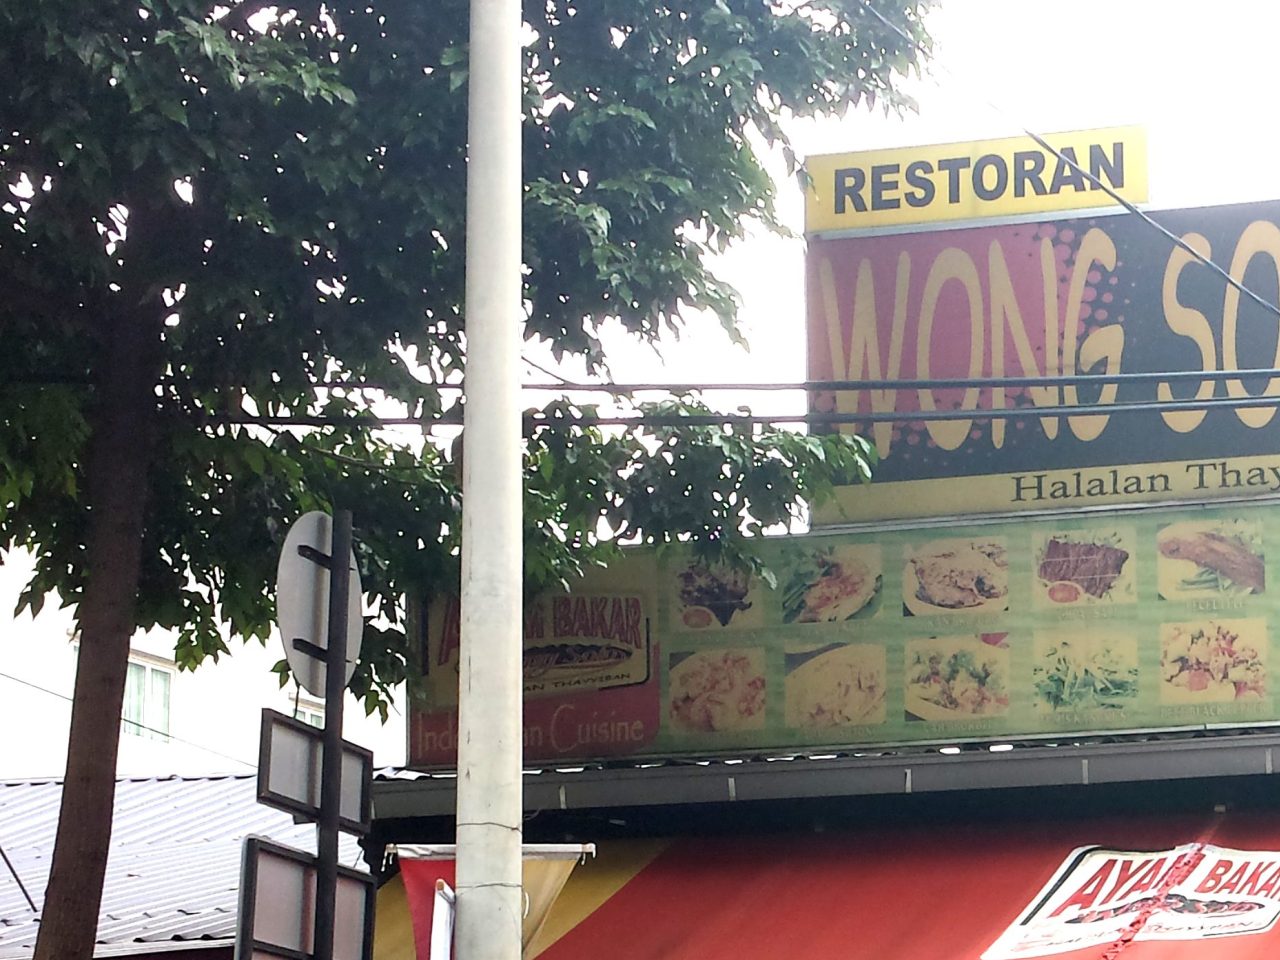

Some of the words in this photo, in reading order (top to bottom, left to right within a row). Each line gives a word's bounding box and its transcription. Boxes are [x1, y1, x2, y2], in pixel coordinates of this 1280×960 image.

[834, 142, 1125, 214] RESTORAN
[819, 227, 1125, 458] WONG
[1011, 468, 1172, 502] Halalan
[553, 597, 642, 648] BAKAR
[551, 704, 644, 752] Cuisine
[1050, 854, 1204, 918] AYAM
